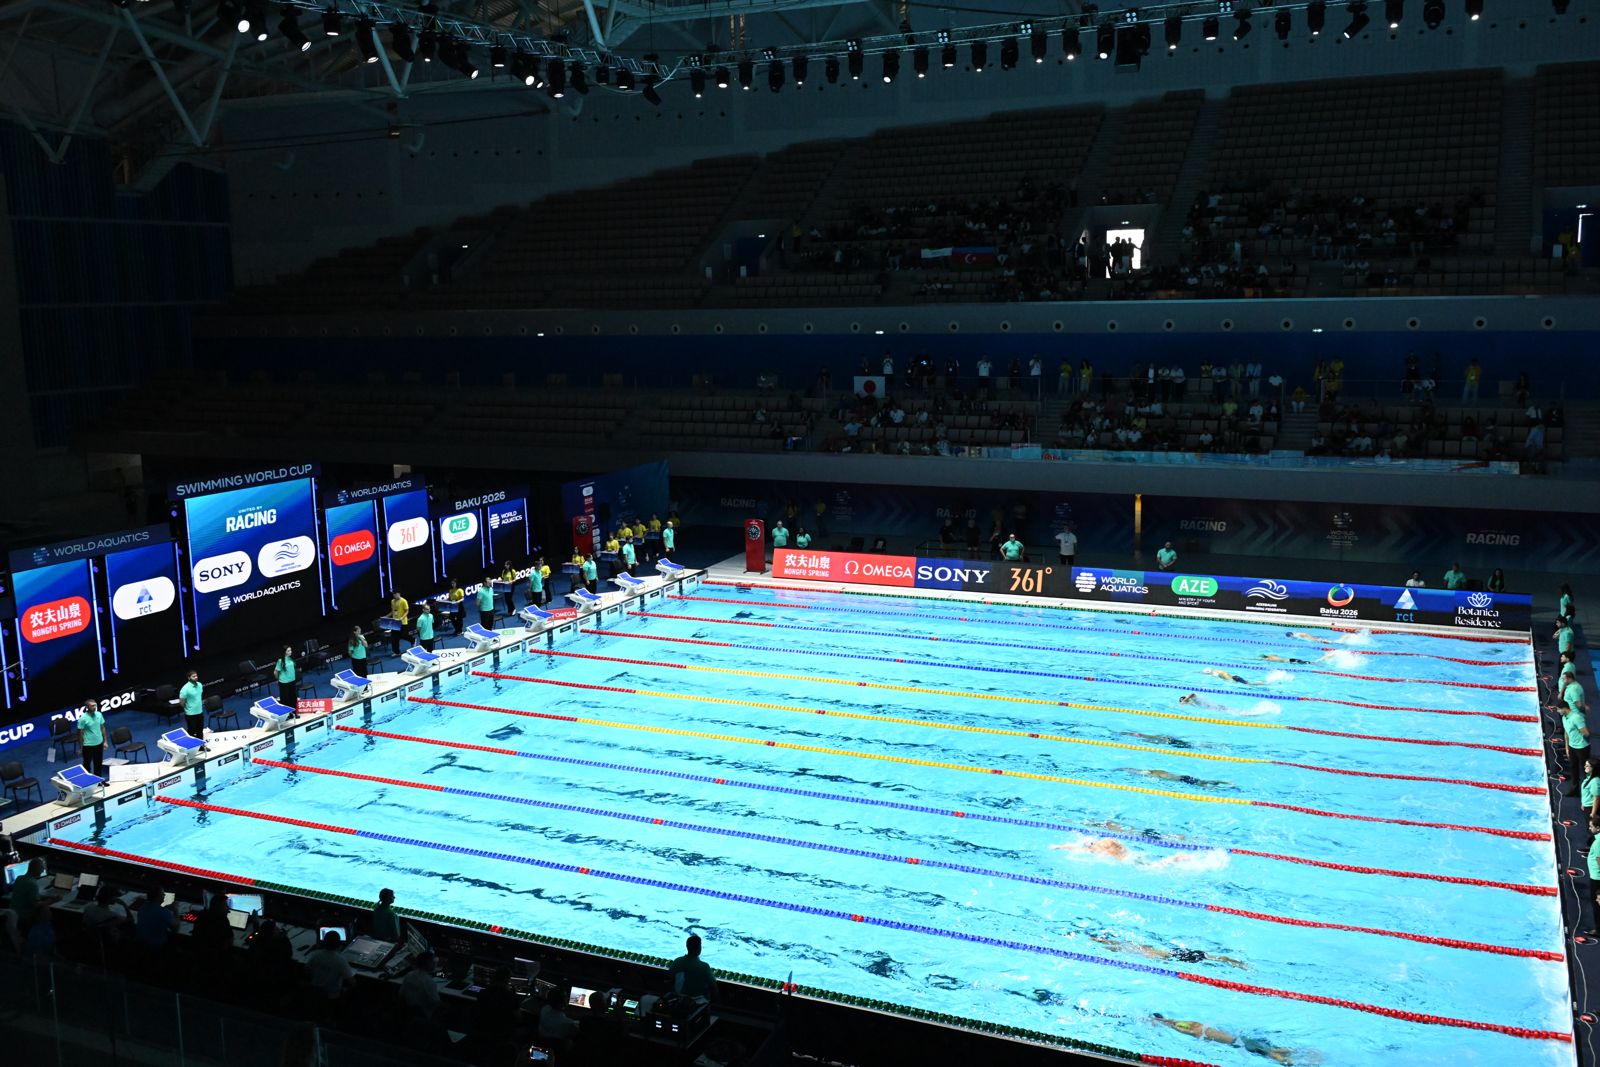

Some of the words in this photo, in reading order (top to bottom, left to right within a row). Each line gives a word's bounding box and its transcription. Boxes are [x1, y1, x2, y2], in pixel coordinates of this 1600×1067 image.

[176, 475, 243, 496] SWIMMING
[244, 468, 288, 484] WORLD
[289, 463, 313, 477] CUP
[350, 486, 377, 498] WORLD
[377, 480, 412, 495] AQUATICS
[455, 496, 481, 510] BAKU
[482, 491, 506, 505] 2026
[226, 508, 277, 533] RACING
[452, 519, 467, 531] AZE
[1180, 519, 1227, 532] RACING
[53, 541, 96, 557] WORLD
[96, 532, 150, 549] AQUATICS
[1466, 532, 1520, 546] RACING
[344, 540, 372, 554] OMEGA
[784, 554, 831, 570] 农夫山泉
[199, 561, 246, 582] SONY
[807, 569, 830, 577] SPRING
[862, 563, 913, 578] OMEGA
[917, 565, 990, 584] SONY
[1100, 576, 1137, 585] WORLD
[1178, 579, 1210, 594] AZE
[233, 590, 263, 604] WORLD
[263, 580, 301, 596] AQUATICS
[1099, 584, 1149, 594] AQUATICS
[30, 603, 82, 628] 农夫山泉
[138, 604, 153, 615] rct
[1320, 607, 1339, 615] Baku
[1340, 608, 1358, 616] 2026
[1395, 612, 1415, 622] rct
[1457, 606, 1499, 617] Botanica
[32, 625, 58, 638] NONGFU
[59, 618, 83, 631] SPRING
[1454, 616, 1501, 628] Residence
[437, 651, 462, 659] ONY
[0, 723, 35, 745] CUP
